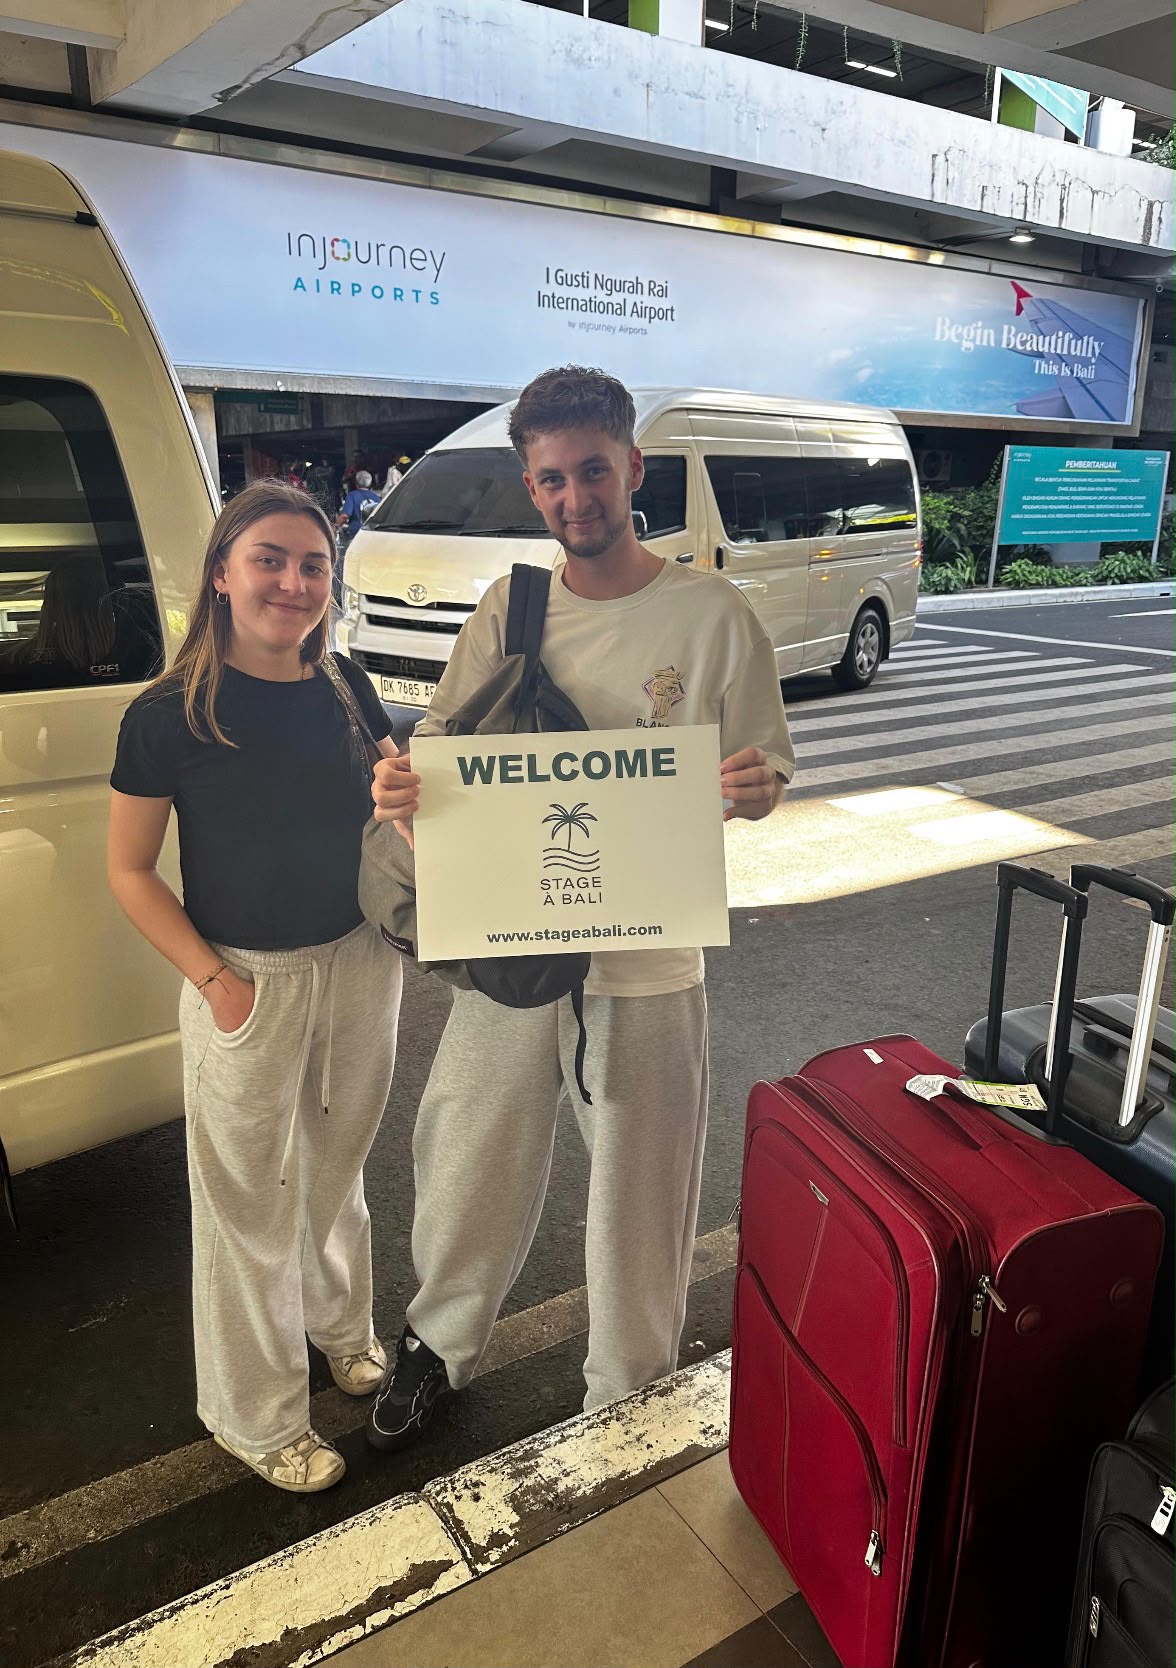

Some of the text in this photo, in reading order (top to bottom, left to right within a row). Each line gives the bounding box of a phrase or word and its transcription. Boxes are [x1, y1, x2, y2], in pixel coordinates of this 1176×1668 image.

[293, 277, 440, 305] AIRPORTS
[546, 266, 669, 298] I Gusti Ngurah Rai
[537, 290, 675, 324] International Airport
[568, 320, 576, 329] by
[619, 325, 648, 335] Airports
[934, 316, 1104, 363] Begin Beautifully
[1033, 359, 1095, 379] This Is Bali
[1065, 460, 1118, 469] PEMBERITAHUAN
[383, 679, 395, 693] DK
[397, 681, 420, 696] 7685
[457, 747, 677, 786] WELCOME
[540, 876, 602, 891] STAGE
[543, 891, 602, 906] À BALI
[486, 923, 663, 944] www.stageabali.com
